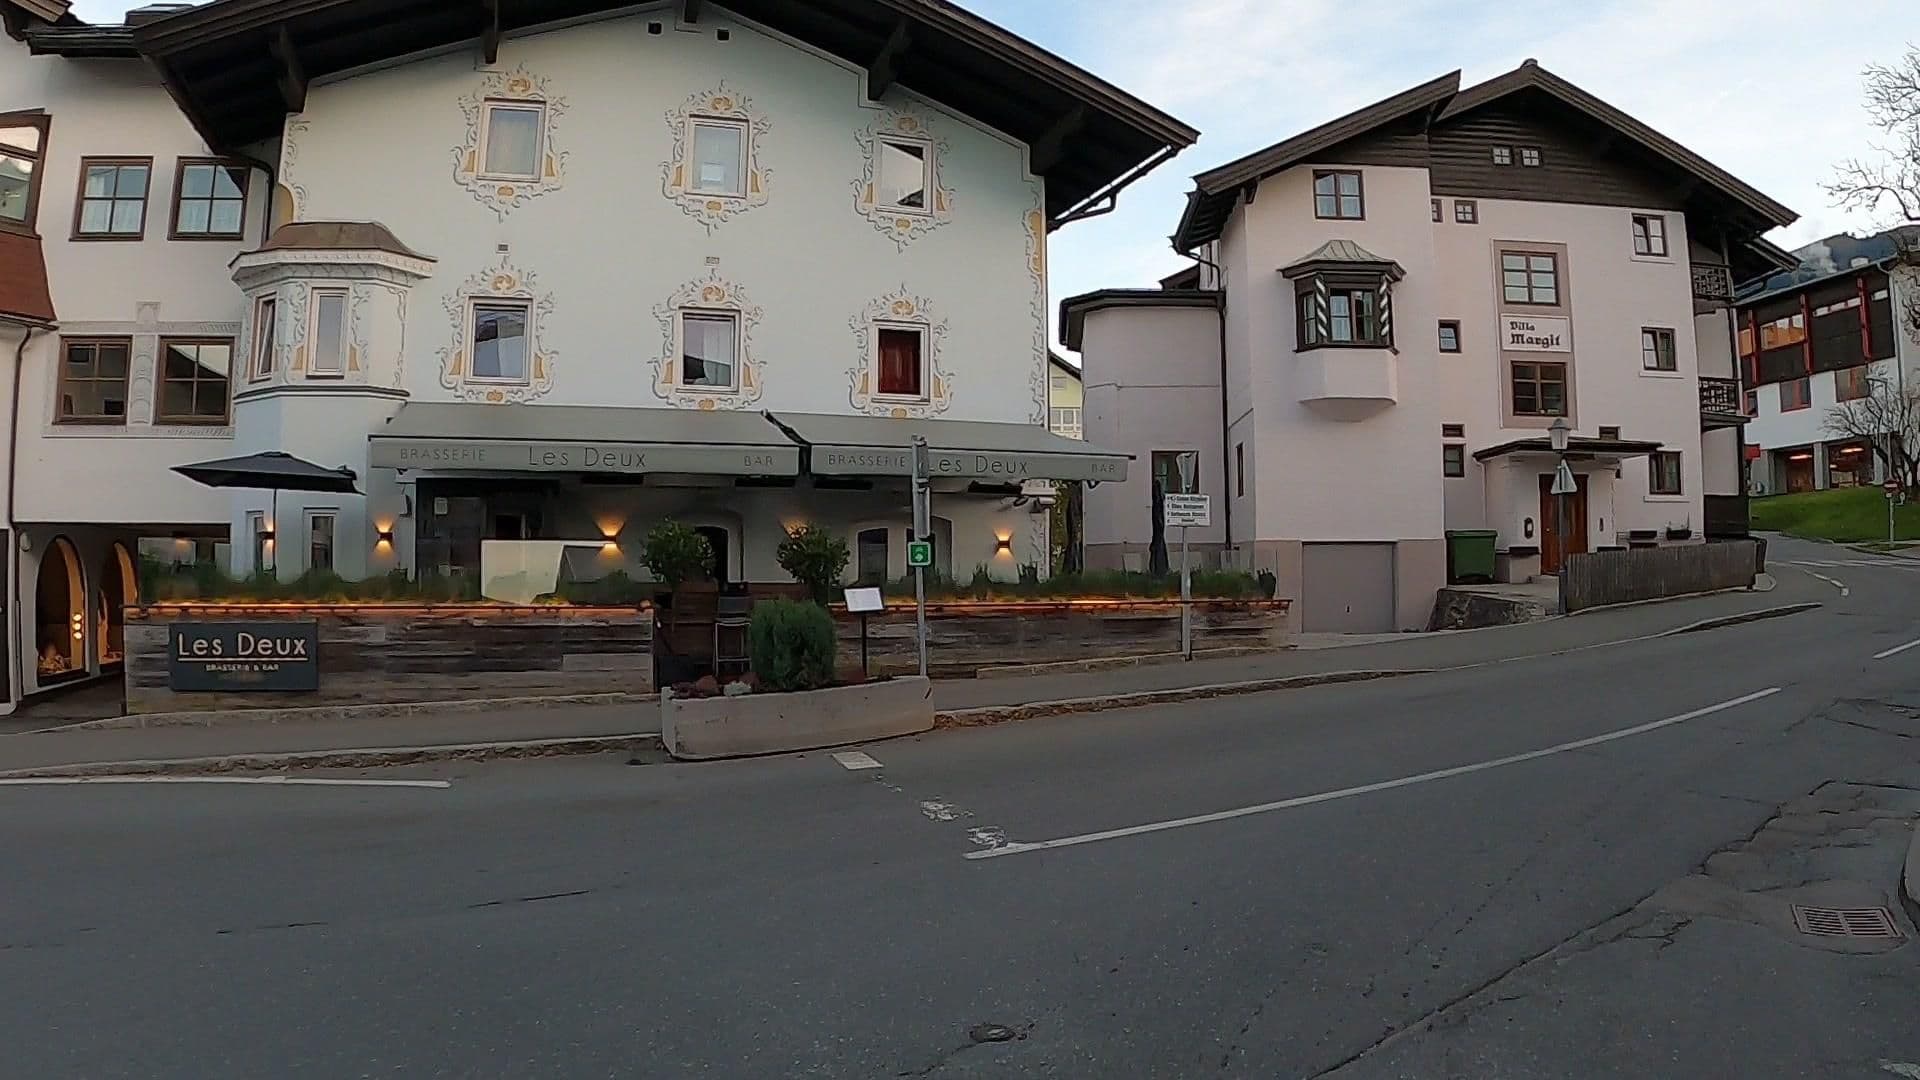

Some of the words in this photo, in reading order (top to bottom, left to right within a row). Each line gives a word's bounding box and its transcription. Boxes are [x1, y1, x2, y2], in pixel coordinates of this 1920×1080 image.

[1510, 333, 1561, 348] Margit
[400, 448, 486, 461] BRASSERIE
[529, 447, 568, 466] Les
[584, 447, 646, 468] Deux
[744, 455, 773, 466] BAR
[828, 454, 905, 467] BRASSERIE
[976, 455, 1028, 474] Deux
[1091, 463, 1115, 473] BAR
[179, 633, 222, 656] Les
[237, 632, 306, 656] Deux
